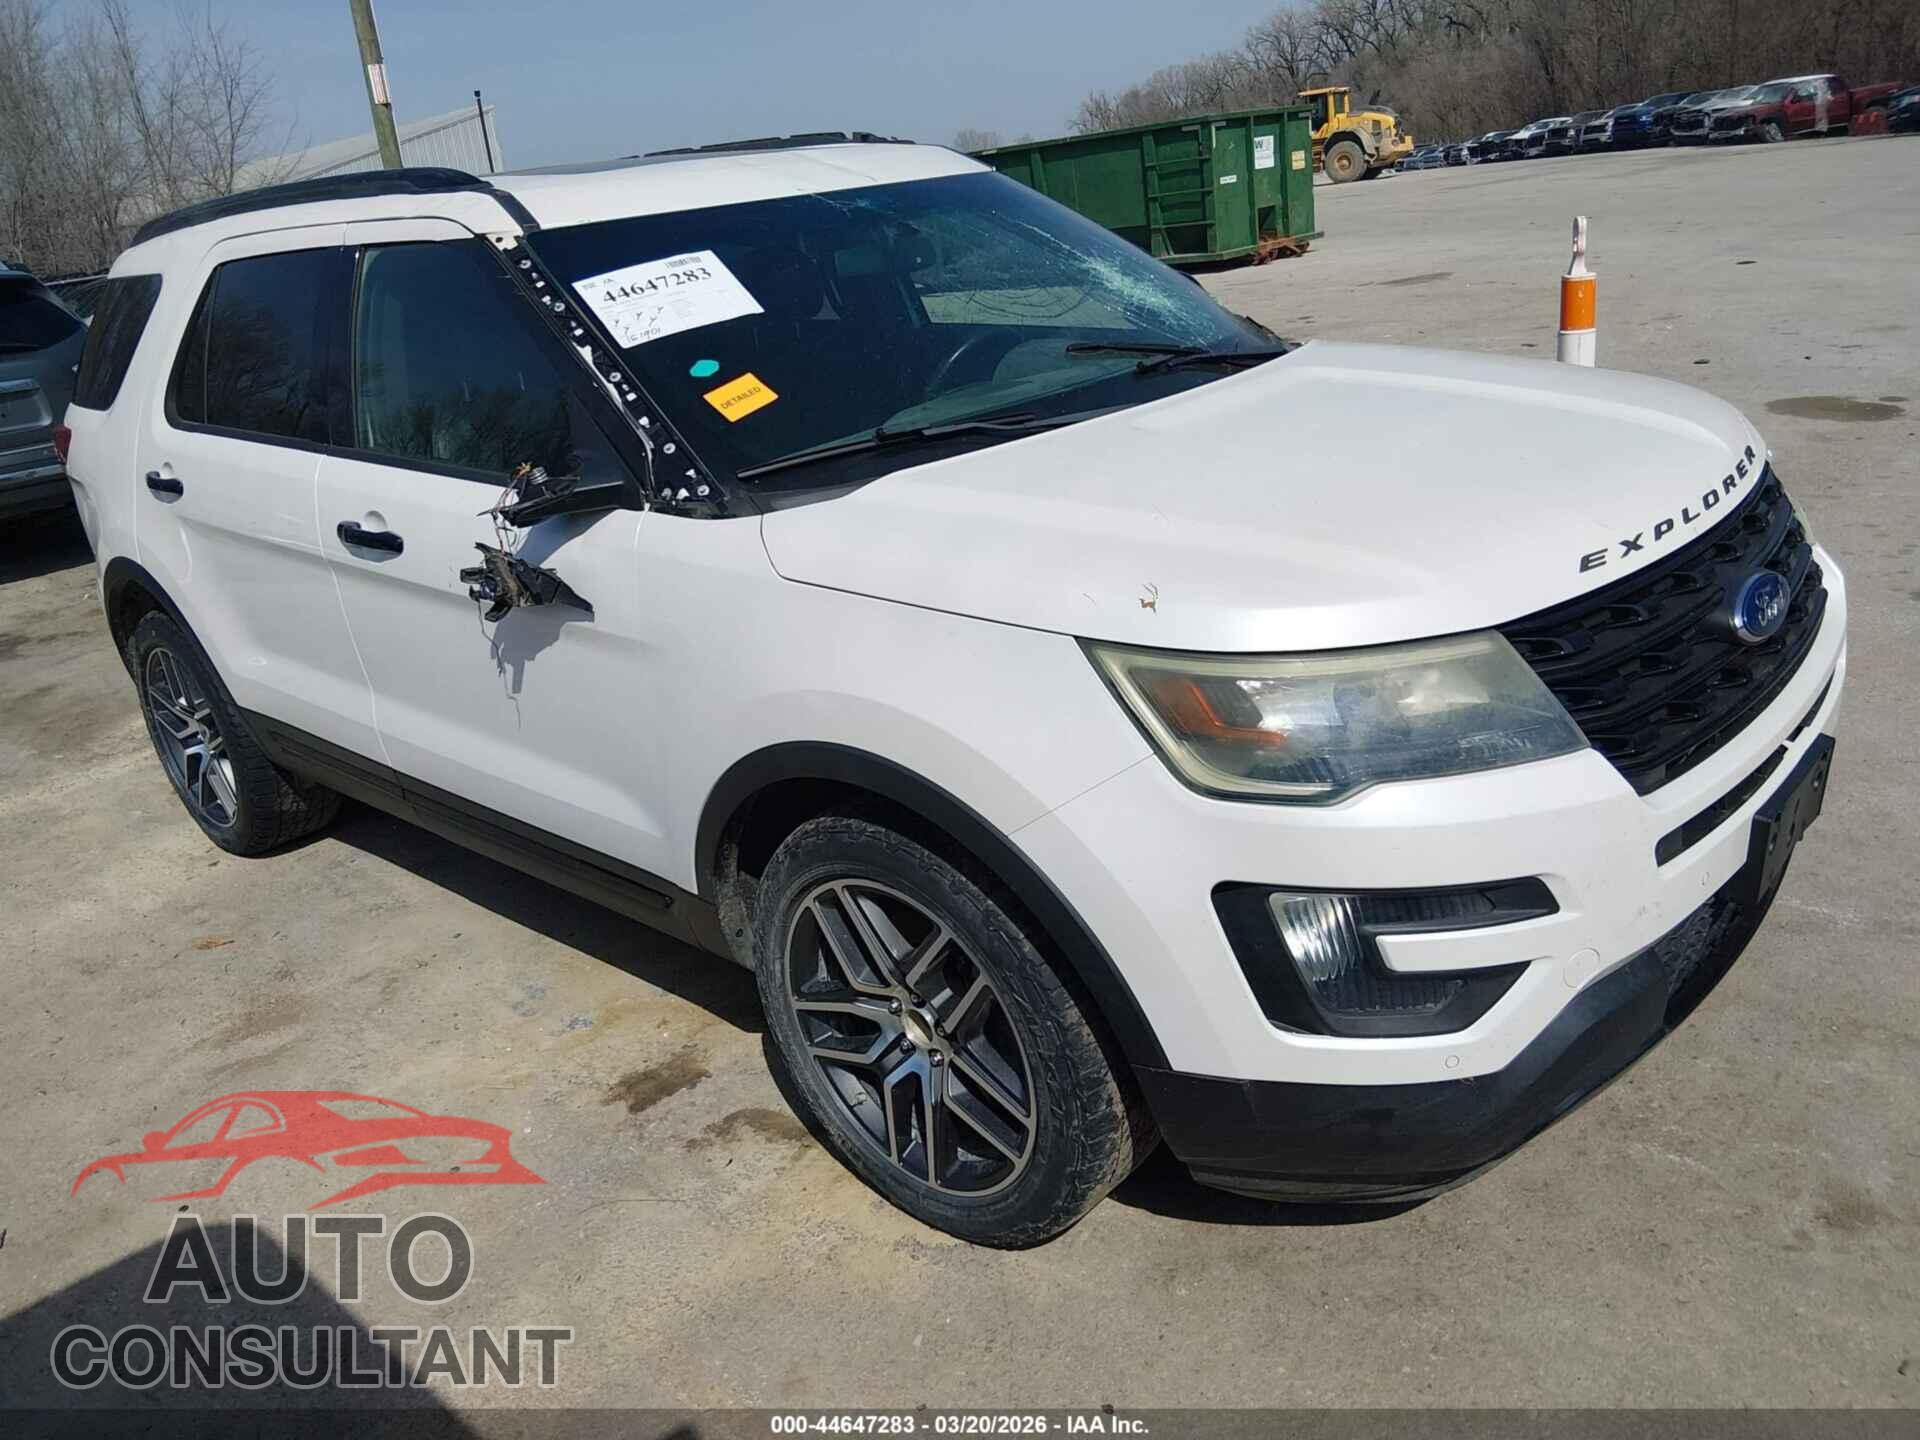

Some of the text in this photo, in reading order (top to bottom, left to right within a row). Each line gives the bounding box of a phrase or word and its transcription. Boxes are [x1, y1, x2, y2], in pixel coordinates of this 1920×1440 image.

[603, 267, 712, 303] 44647283
[721, 386, 761, 409] DETAILED
[1579, 444, 1756, 573] EXPLORER
